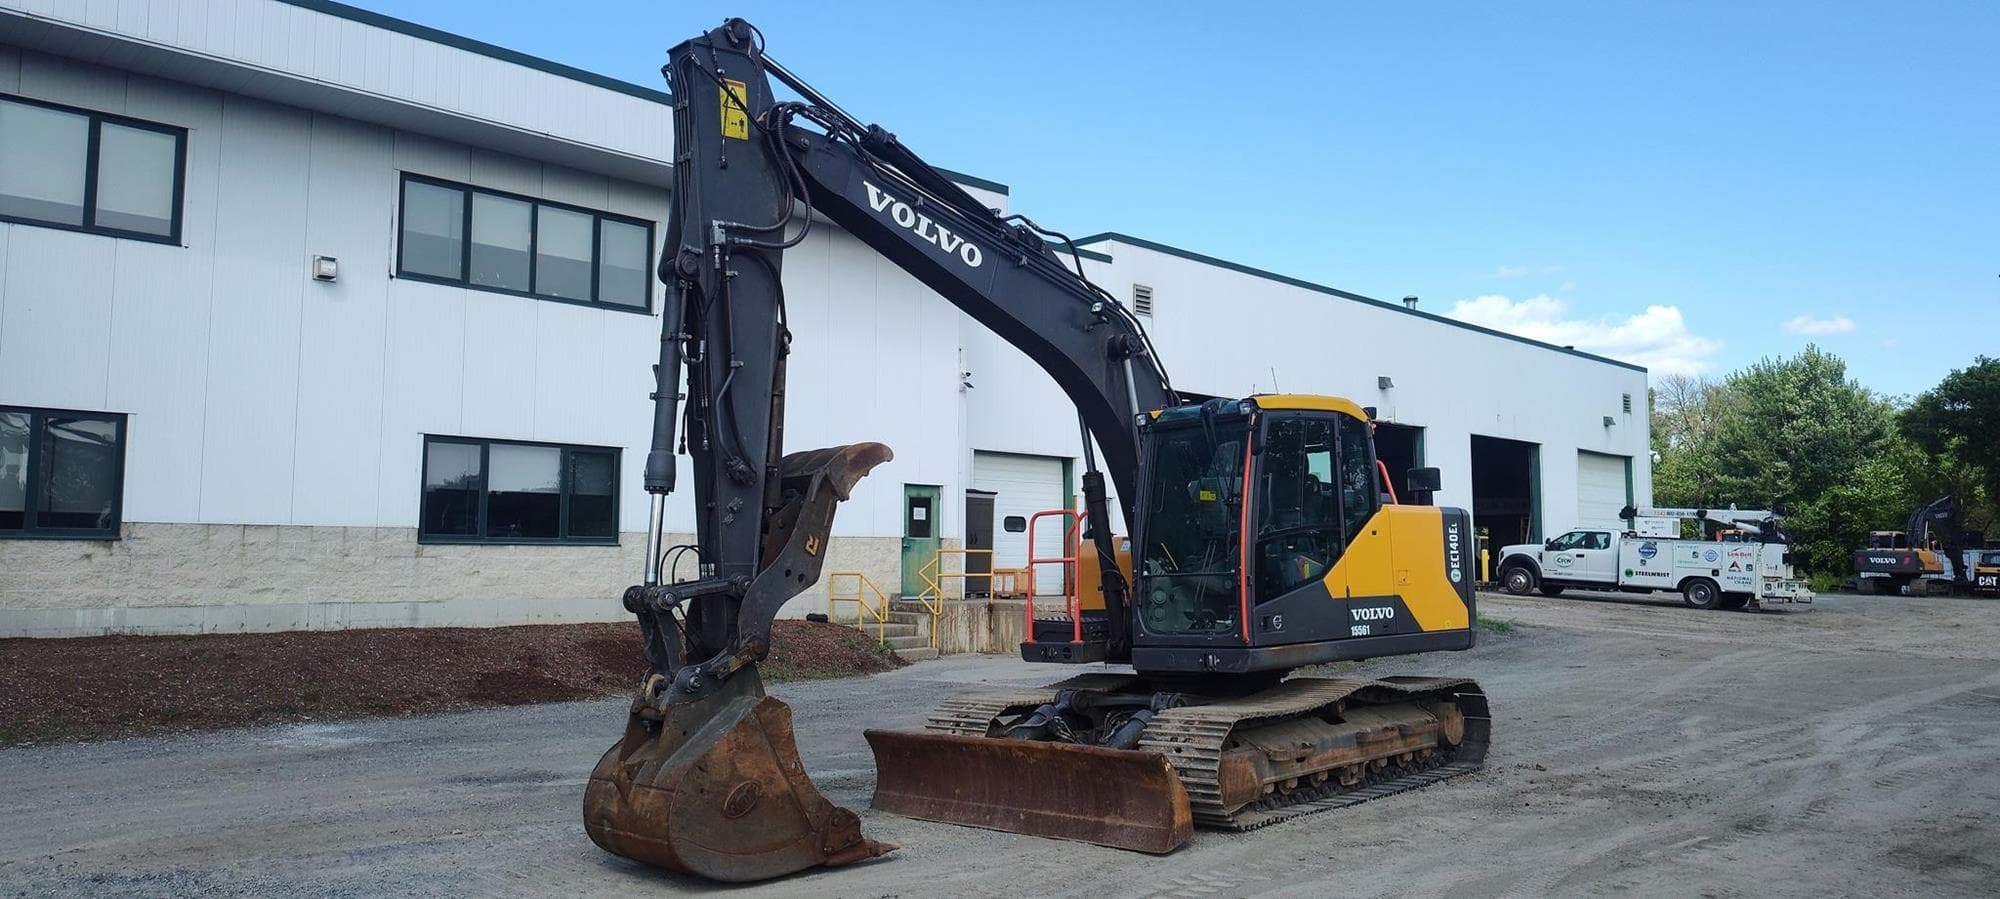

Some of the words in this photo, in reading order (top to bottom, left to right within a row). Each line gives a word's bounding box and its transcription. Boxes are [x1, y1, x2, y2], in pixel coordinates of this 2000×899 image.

[863, 180, 983, 268] VOLVO
[1869, 556, 1897, 565] VOLVO
[1635, 570, 1670, 578] STEELWRIST
[1978, 575, 1998, 587] CAT
[1350, 606, 1395, 621] VOLVO
[1350, 624, 1370, 637] 15561
